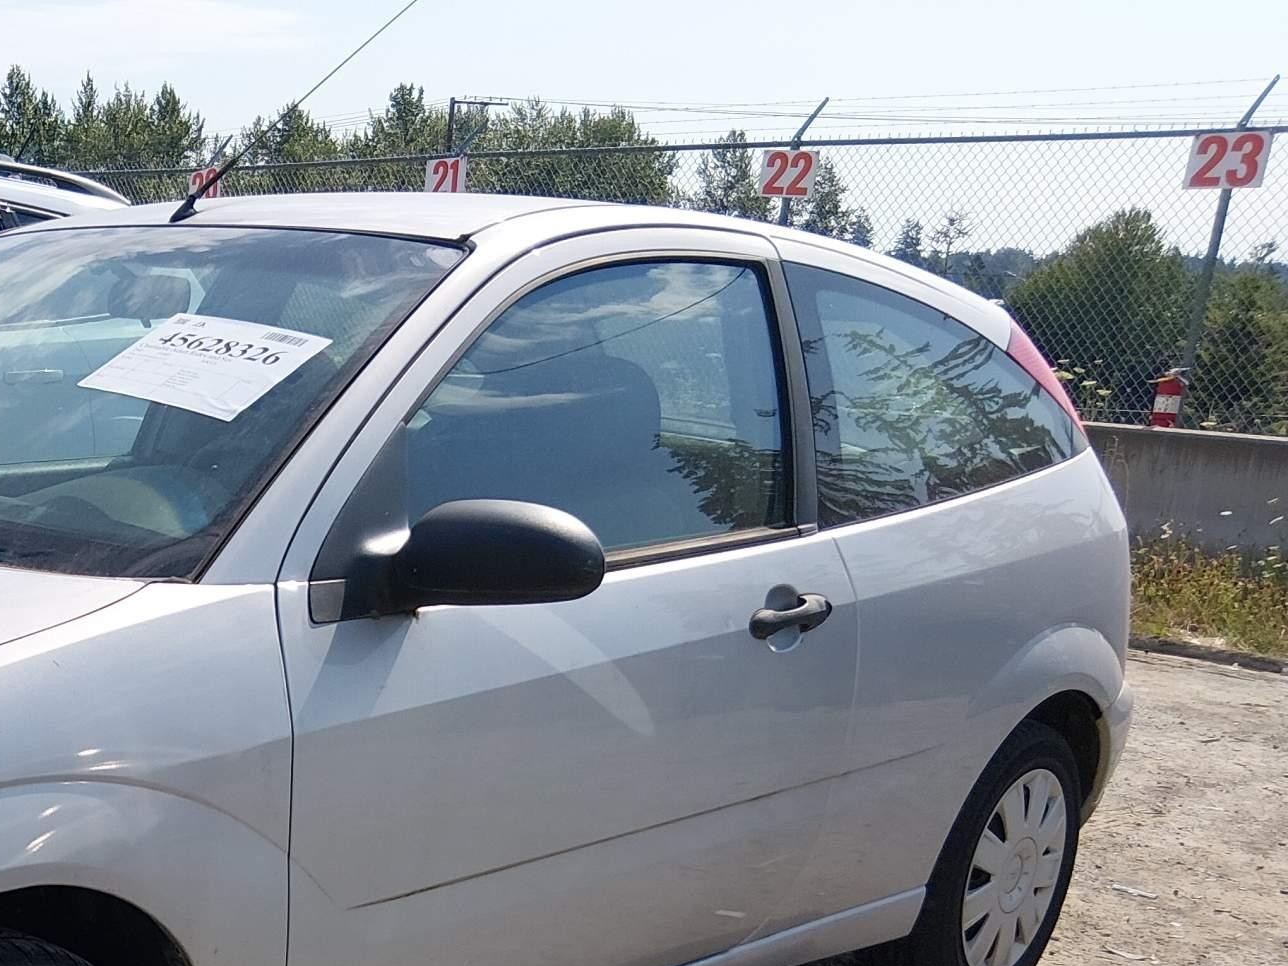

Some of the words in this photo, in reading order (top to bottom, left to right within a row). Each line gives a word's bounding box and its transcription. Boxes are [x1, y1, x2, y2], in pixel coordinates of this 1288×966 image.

[432, 160, 459, 192] 21
[762, 151, 812, 195] 22
[1188, 133, 1264, 187] 23
[159, 332, 288, 365] 45628326
